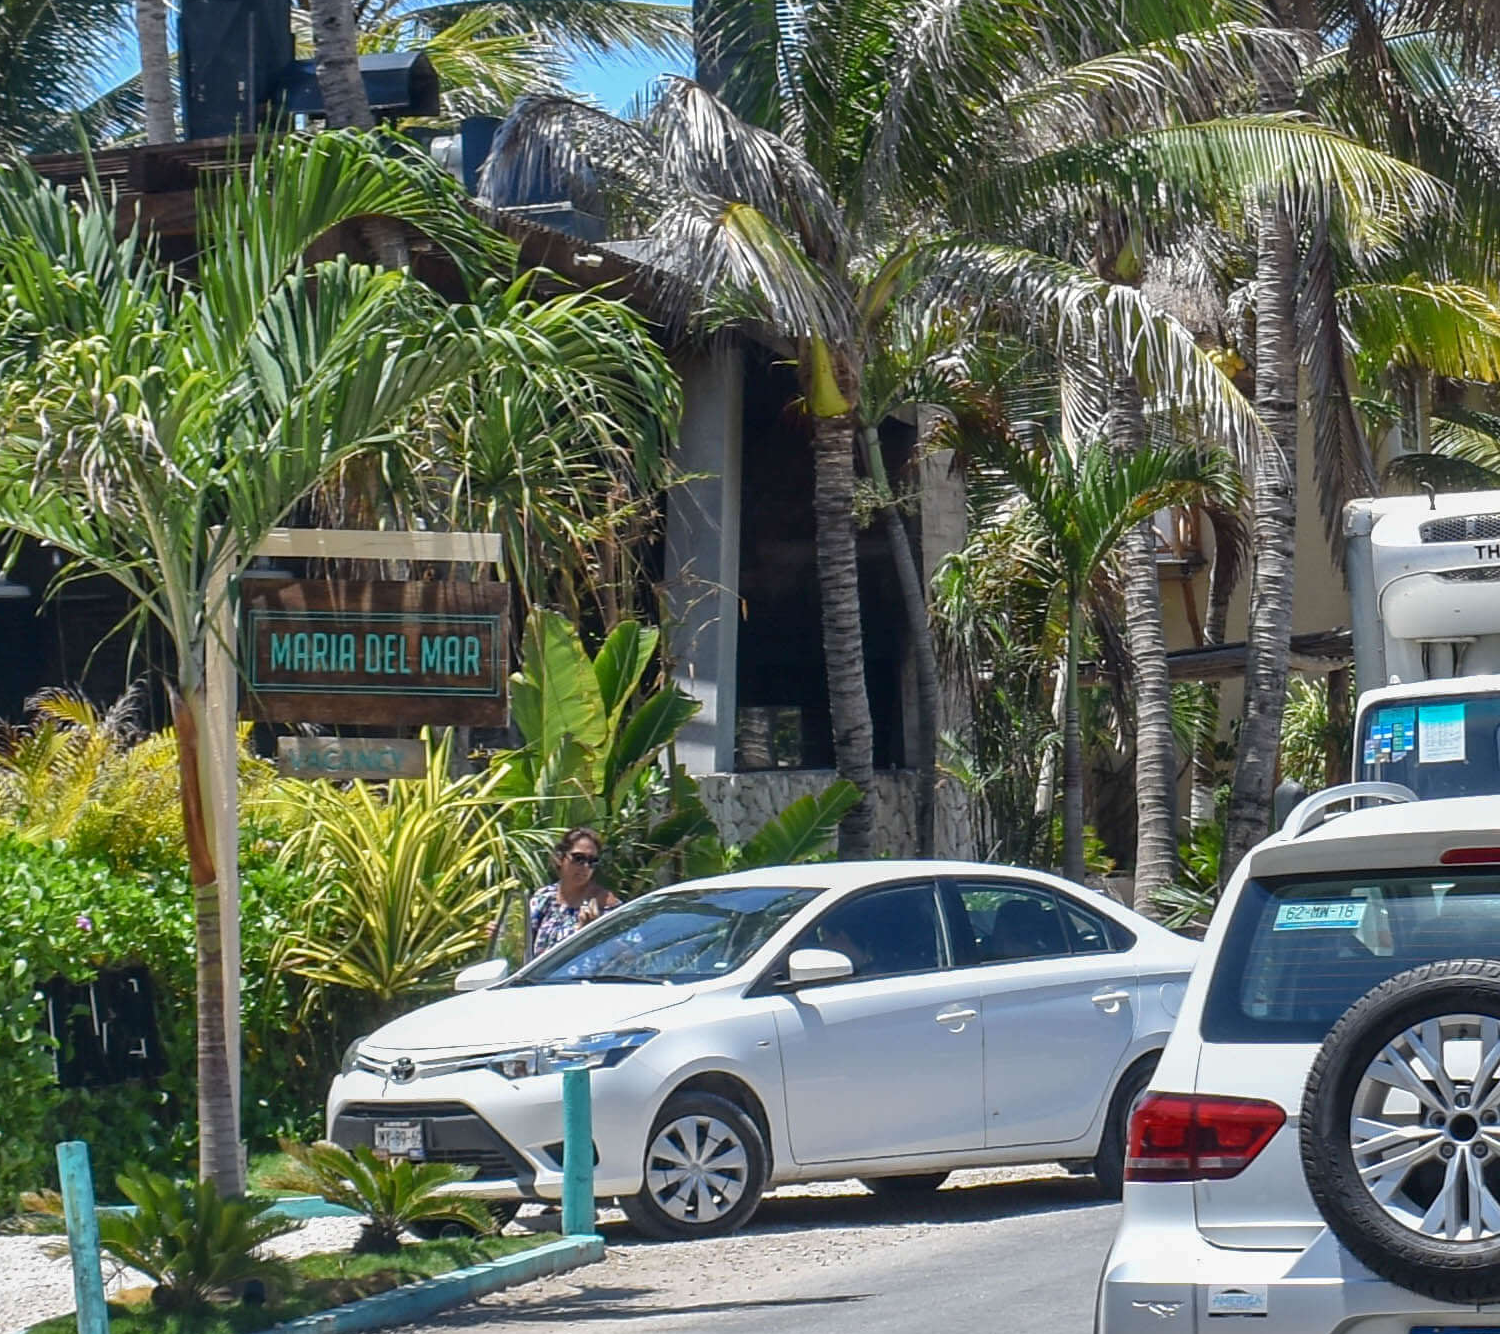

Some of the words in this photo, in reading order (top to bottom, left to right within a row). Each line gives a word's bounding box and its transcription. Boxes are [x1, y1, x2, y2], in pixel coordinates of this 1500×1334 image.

[270, 632, 357, 673] MARIA
[364, 633, 412, 675] DEL
[420, 635, 481, 677] MAR
